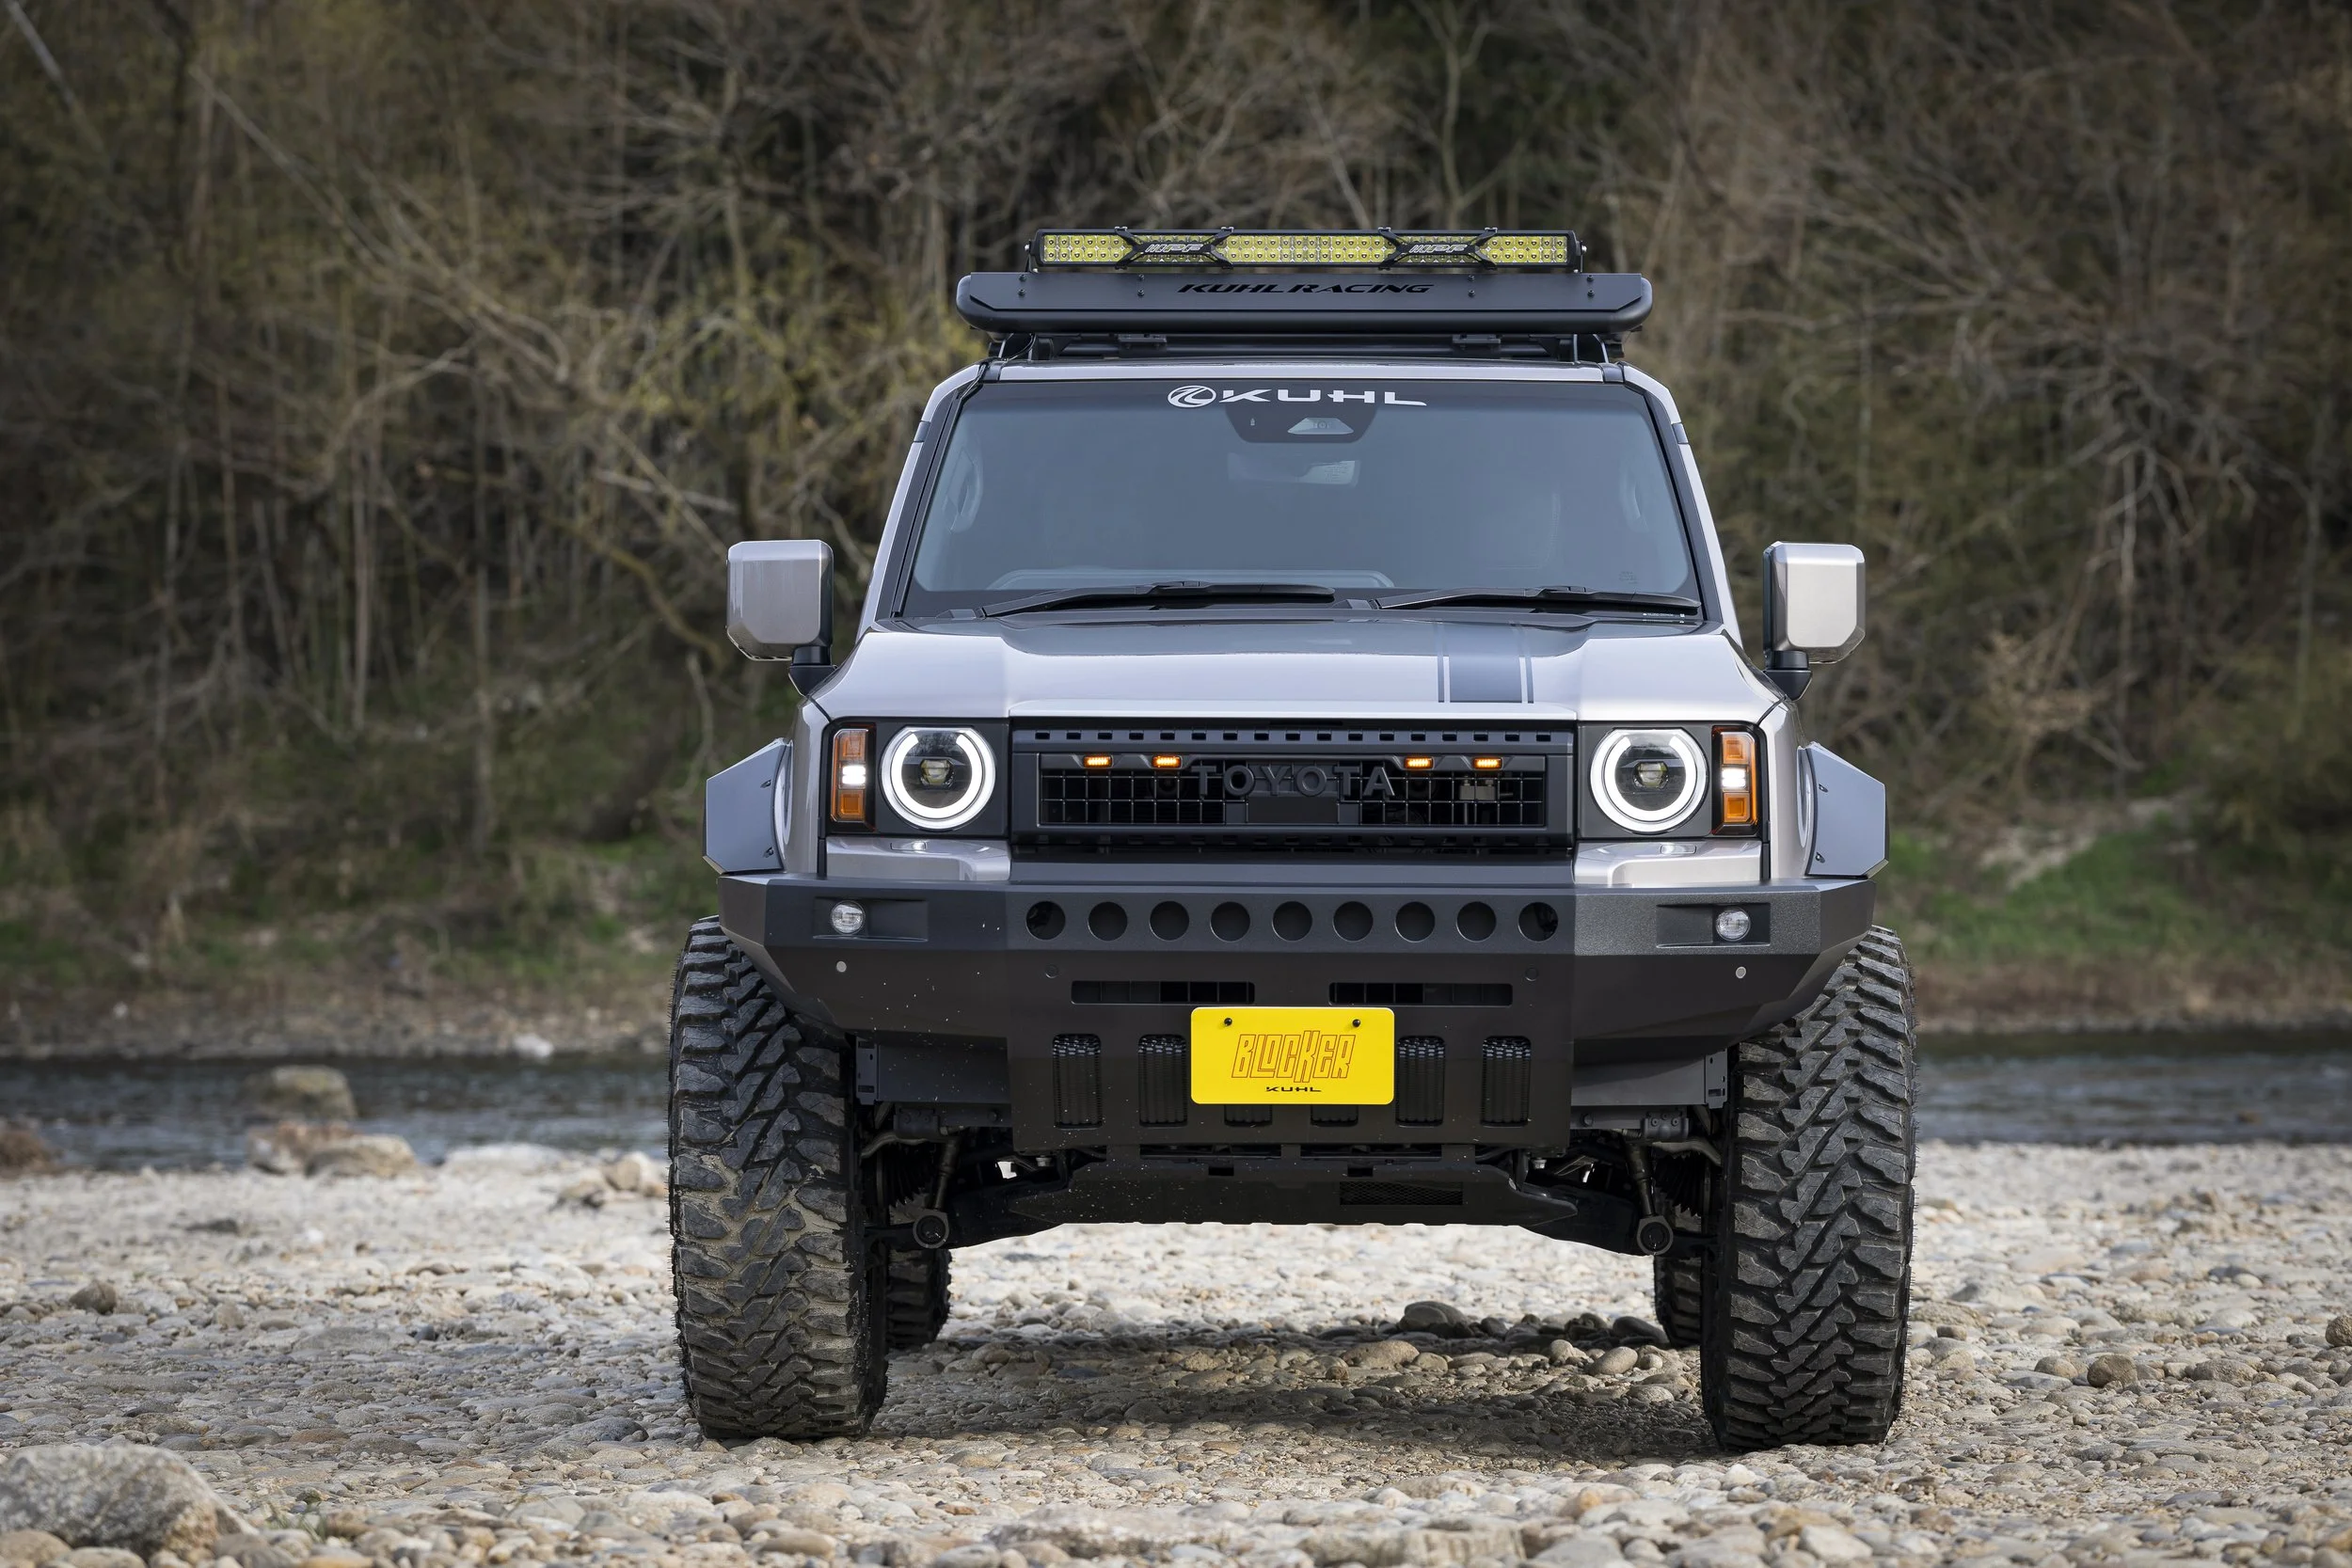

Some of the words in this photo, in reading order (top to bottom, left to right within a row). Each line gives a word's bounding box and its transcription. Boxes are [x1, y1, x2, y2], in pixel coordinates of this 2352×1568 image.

[1177, 284, 1285, 293] KUHL
[1287, 284, 1435, 293] RACING
[1219, 388, 1427, 405] KUHL
[1191, 765, 1395, 797] TOYOTA
[1231, 1030, 1357, 1083] BLOCKER
